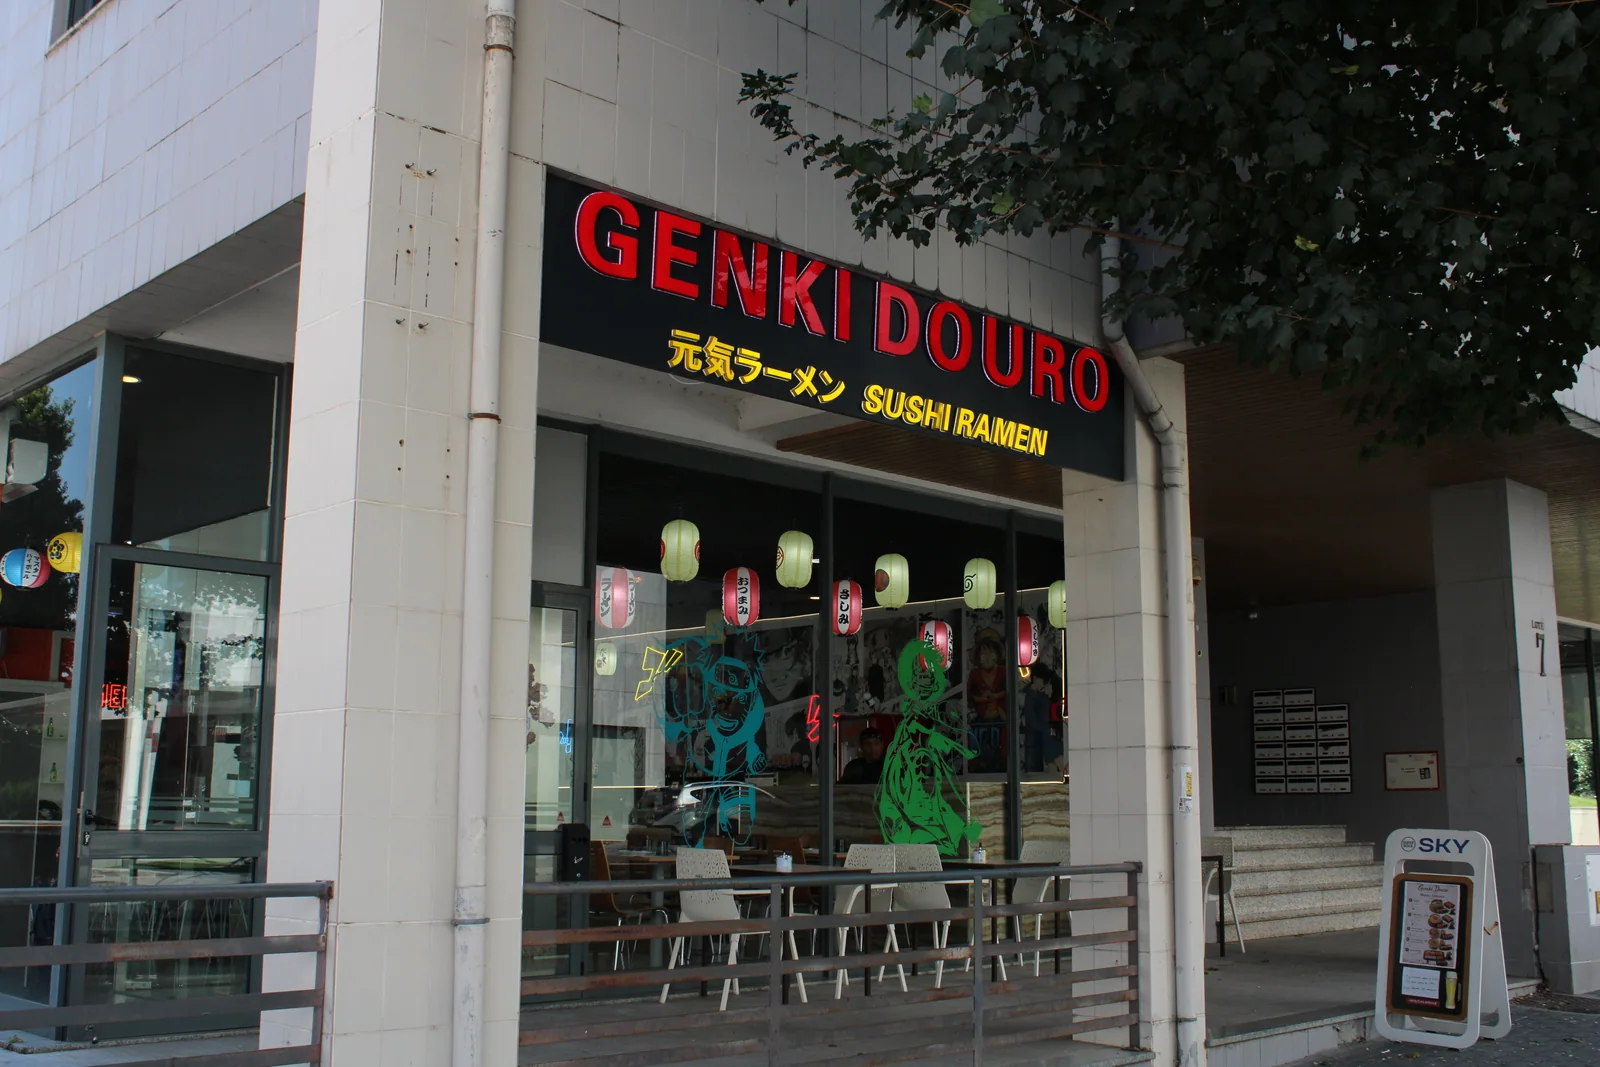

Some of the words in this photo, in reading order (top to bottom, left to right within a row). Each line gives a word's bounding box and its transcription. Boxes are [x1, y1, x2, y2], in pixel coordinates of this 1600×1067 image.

[574, 190, 852, 342] GENKI
[873, 281, 1110, 414] DOURO
[668, 328, 847, 404] 元気ラーメン
[862, 384, 952, 433] SUSHI
[953, 406, 1049, 457] RAMEN
[600, 578, 611, 617] ラーメン
[738, 577, 749, 615] おつまみ
[838, 589, 850, 625] さしみ
[1536, 633, 1546, 677] 7
[1419, 838, 1470, 854] SKY
